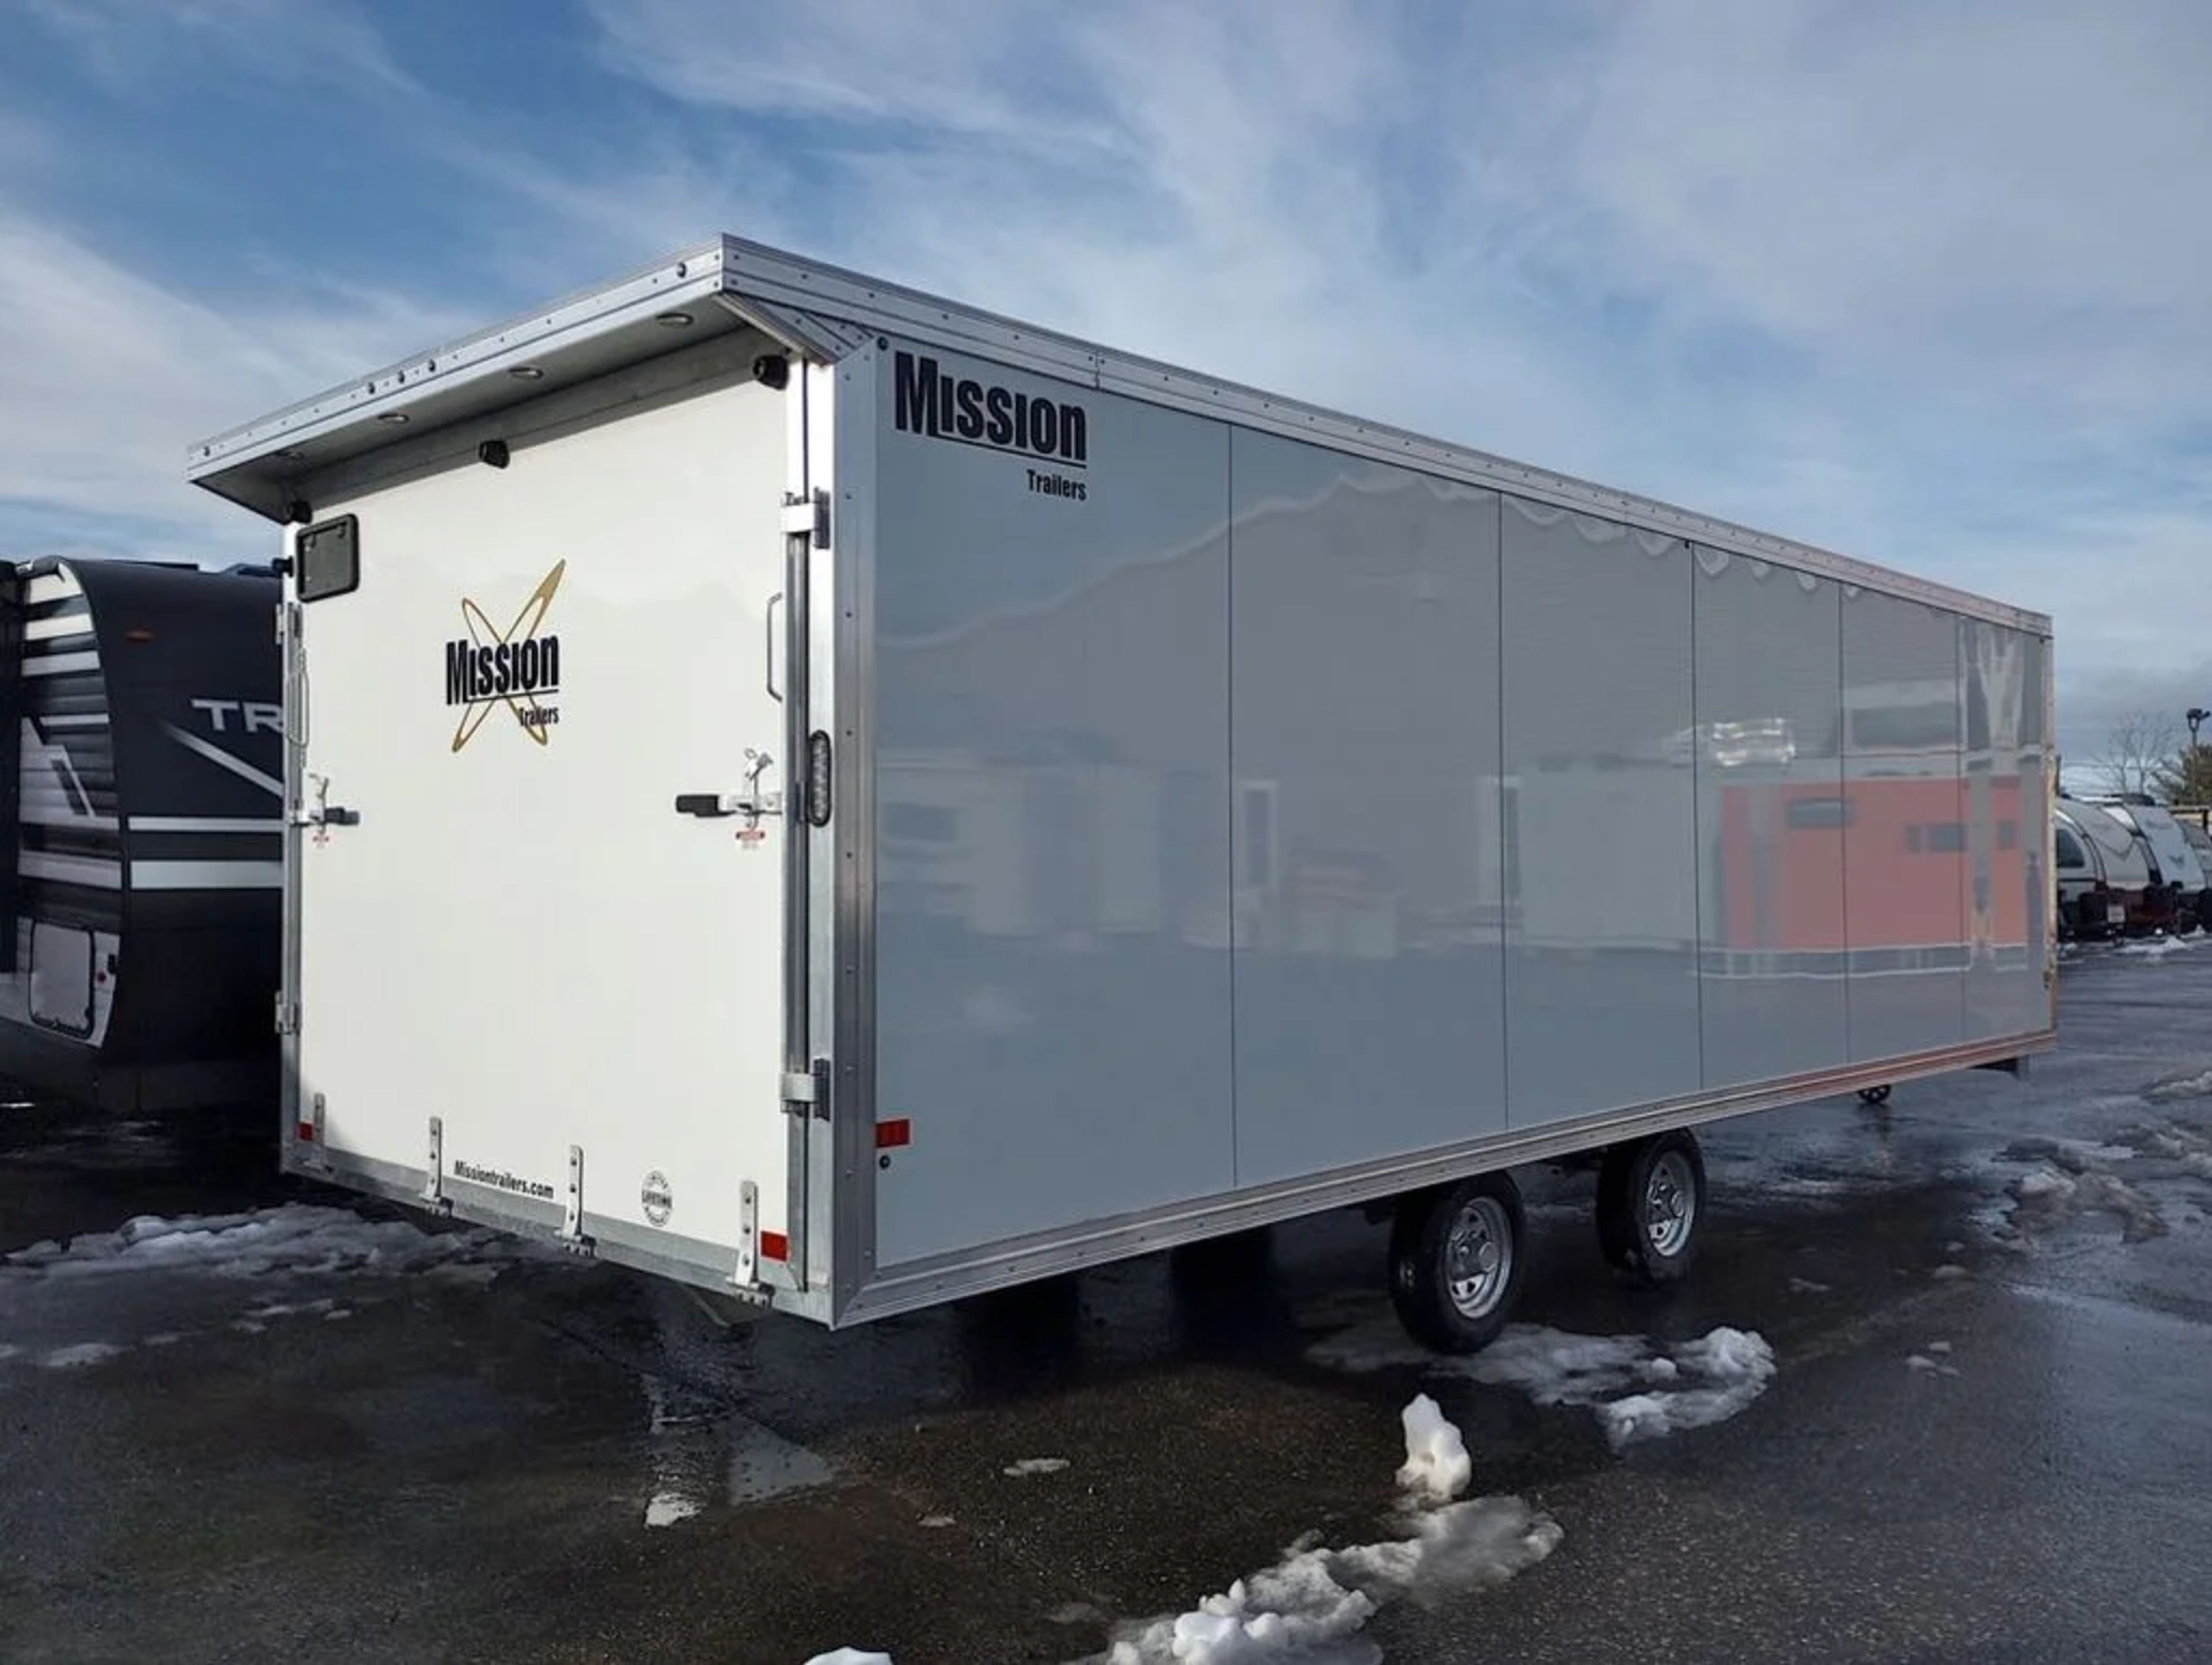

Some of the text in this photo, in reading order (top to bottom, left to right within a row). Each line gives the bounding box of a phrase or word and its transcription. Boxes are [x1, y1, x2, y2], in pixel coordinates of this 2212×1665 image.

[1027, 469, 1086, 501] Trailers
[518, 707, 559, 726] Trailers
[454, 1159, 554, 1200] Missiontrailers.com
